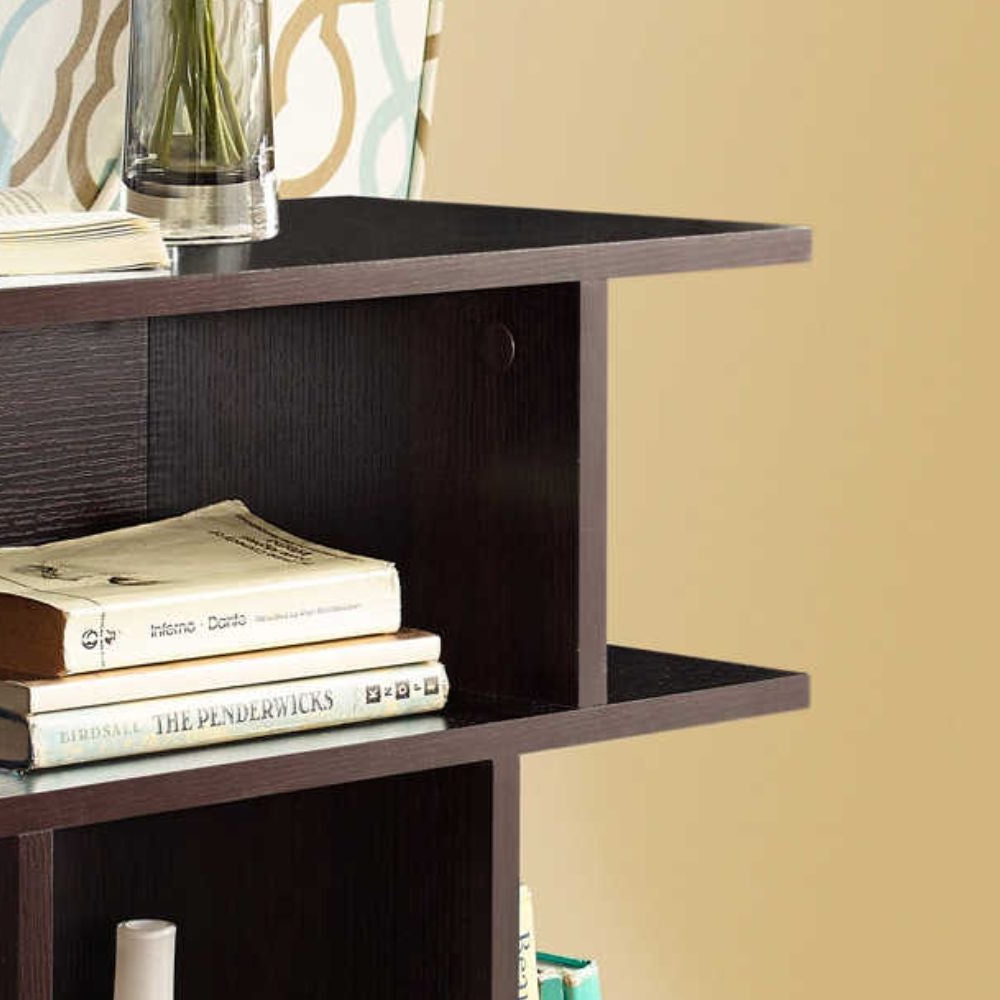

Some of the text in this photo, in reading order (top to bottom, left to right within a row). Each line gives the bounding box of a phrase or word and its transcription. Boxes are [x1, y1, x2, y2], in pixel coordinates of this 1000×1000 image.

[150, 619, 196, 638] Inferno
[207, 612, 248, 631] Dante
[152, 710, 193, 735] THE
[197, 690, 335, 730] PENDERWICKS
